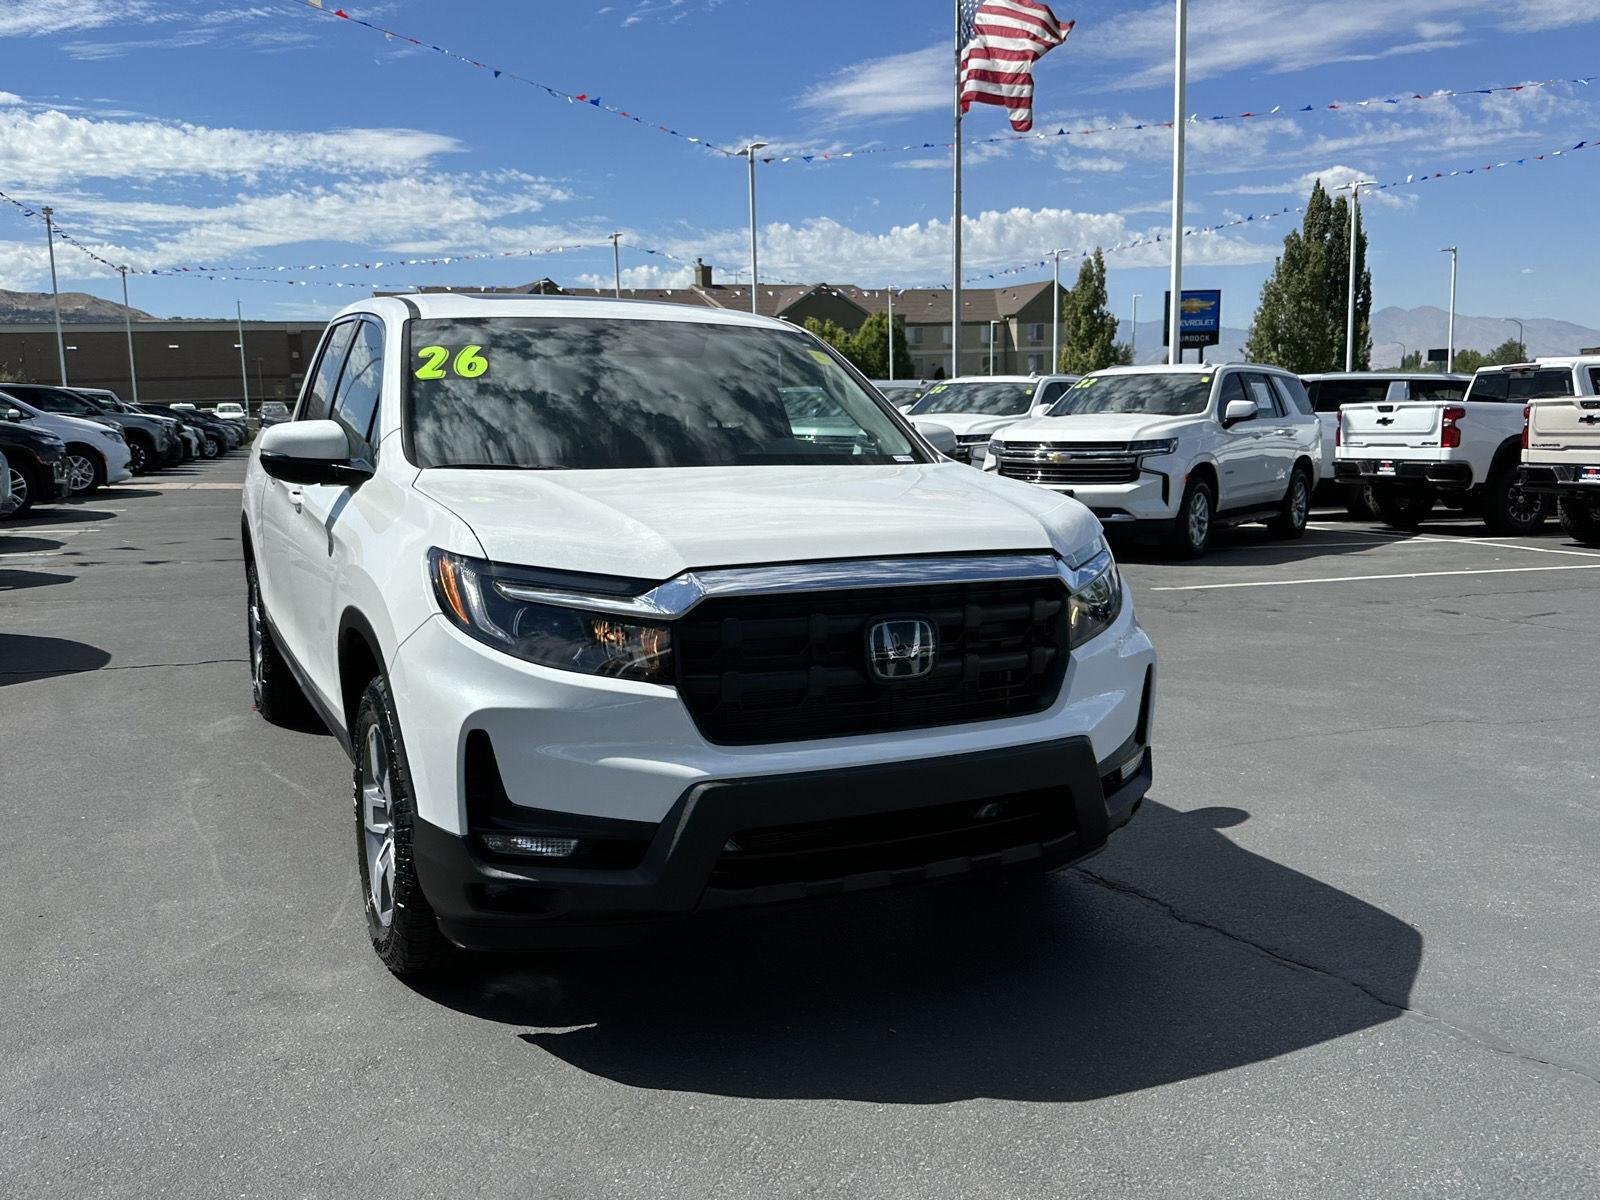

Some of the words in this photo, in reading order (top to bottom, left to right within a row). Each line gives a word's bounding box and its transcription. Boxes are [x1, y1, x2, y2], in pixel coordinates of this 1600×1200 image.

[1180, 319, 1215, 328] EVROLET
[1180, 335, 1211, 343] URDOCK
[414, 344, 489, 380] 26
